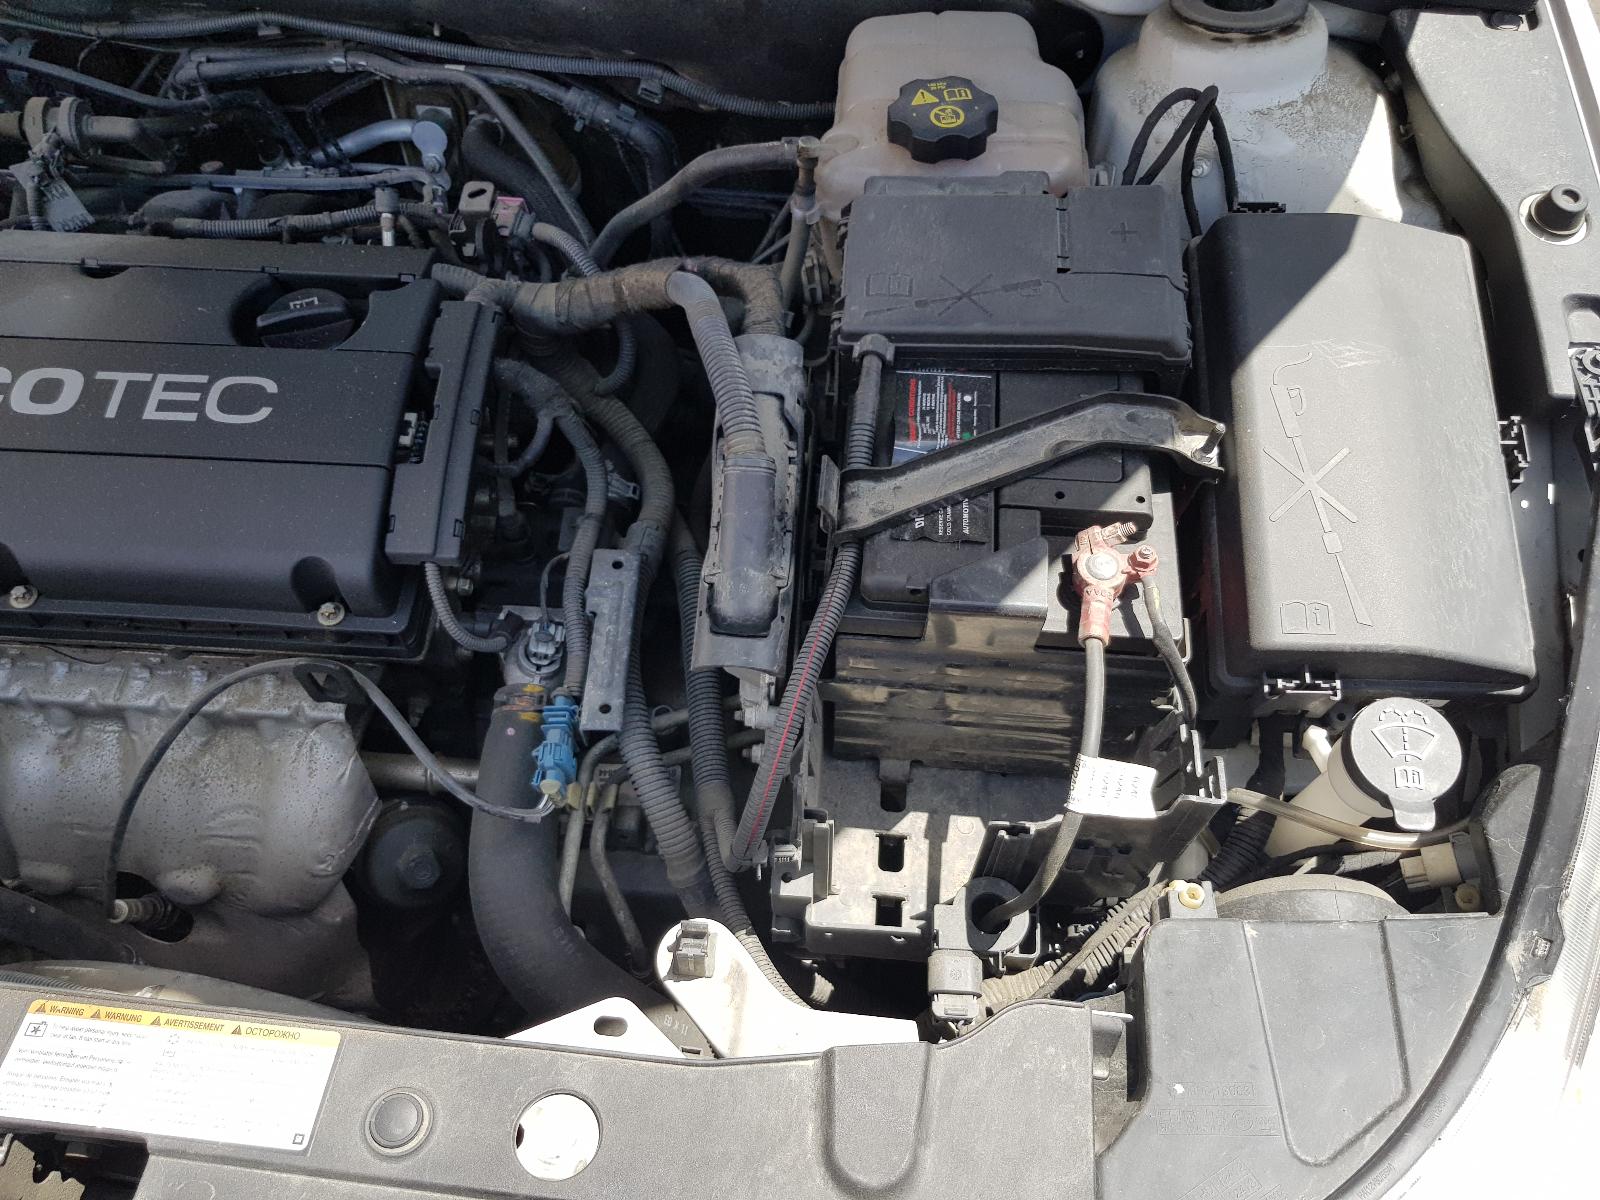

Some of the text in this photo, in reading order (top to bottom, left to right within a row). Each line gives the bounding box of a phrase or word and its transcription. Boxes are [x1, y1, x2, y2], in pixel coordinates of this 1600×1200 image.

[0, 366, 279, 424] OTEC
[49, 1005, 225, 1032] WARNING WARNUNG AVERTISSEMENT
